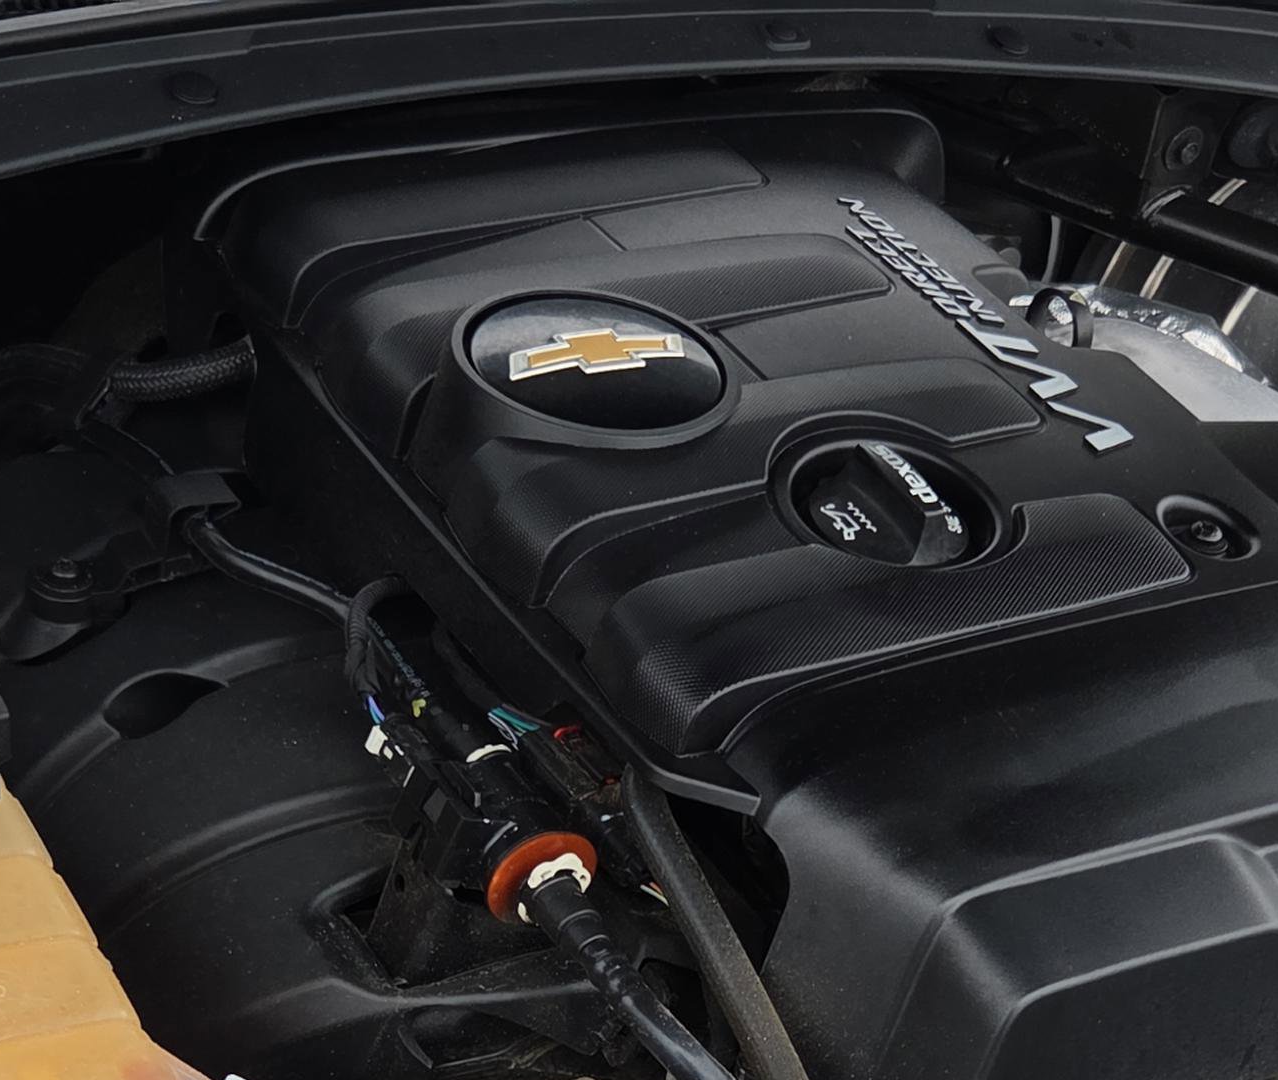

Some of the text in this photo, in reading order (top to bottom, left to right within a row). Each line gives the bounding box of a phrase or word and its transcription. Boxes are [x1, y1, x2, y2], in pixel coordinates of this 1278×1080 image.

[836, 196, 1006, 323] INJECTION
[845, 225, 972, 317] DIRECT
[955, 318, 1135, 451] VVT
[873, 444, 939, 504] dexos
